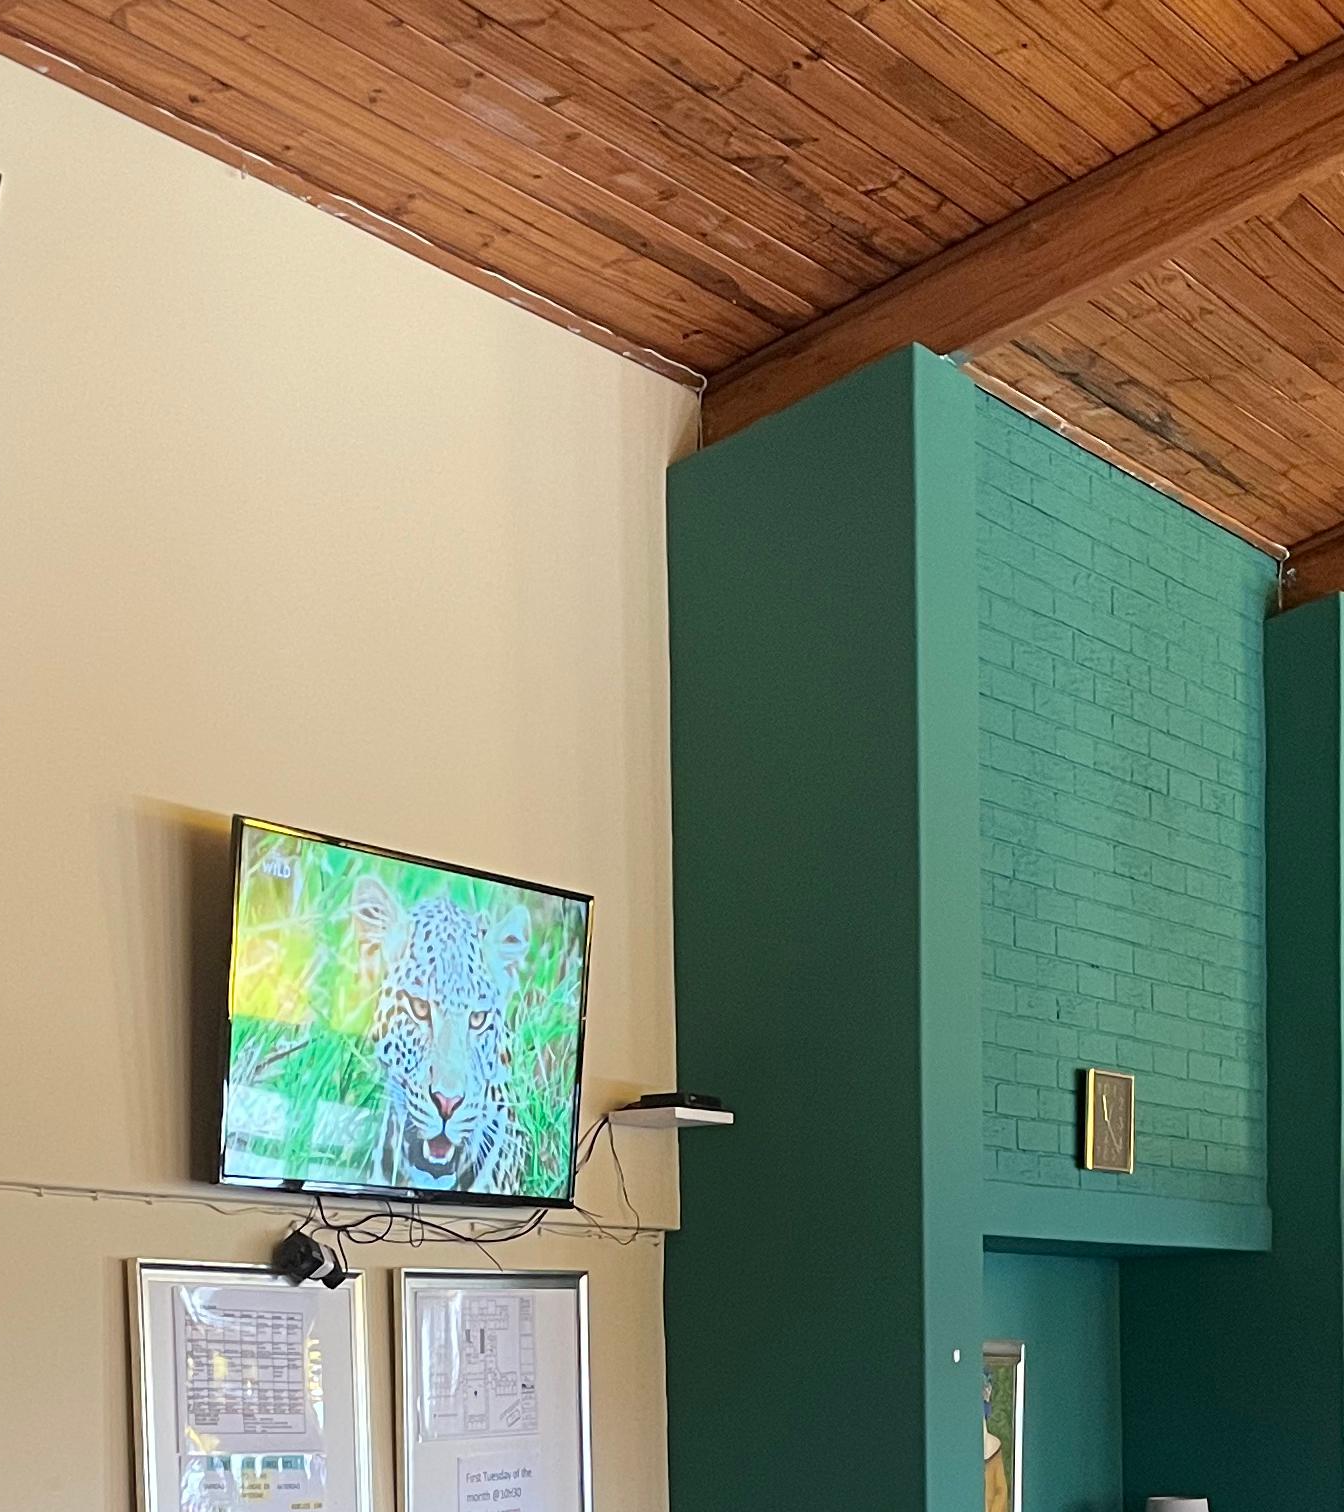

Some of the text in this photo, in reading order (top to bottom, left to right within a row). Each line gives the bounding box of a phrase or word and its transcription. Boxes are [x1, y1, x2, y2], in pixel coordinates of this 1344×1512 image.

[263, 860, 291, 878] WILD
[466, 1468, 533, 1484] First Tuesday of the
[466, 1491, 491, 1503] month
